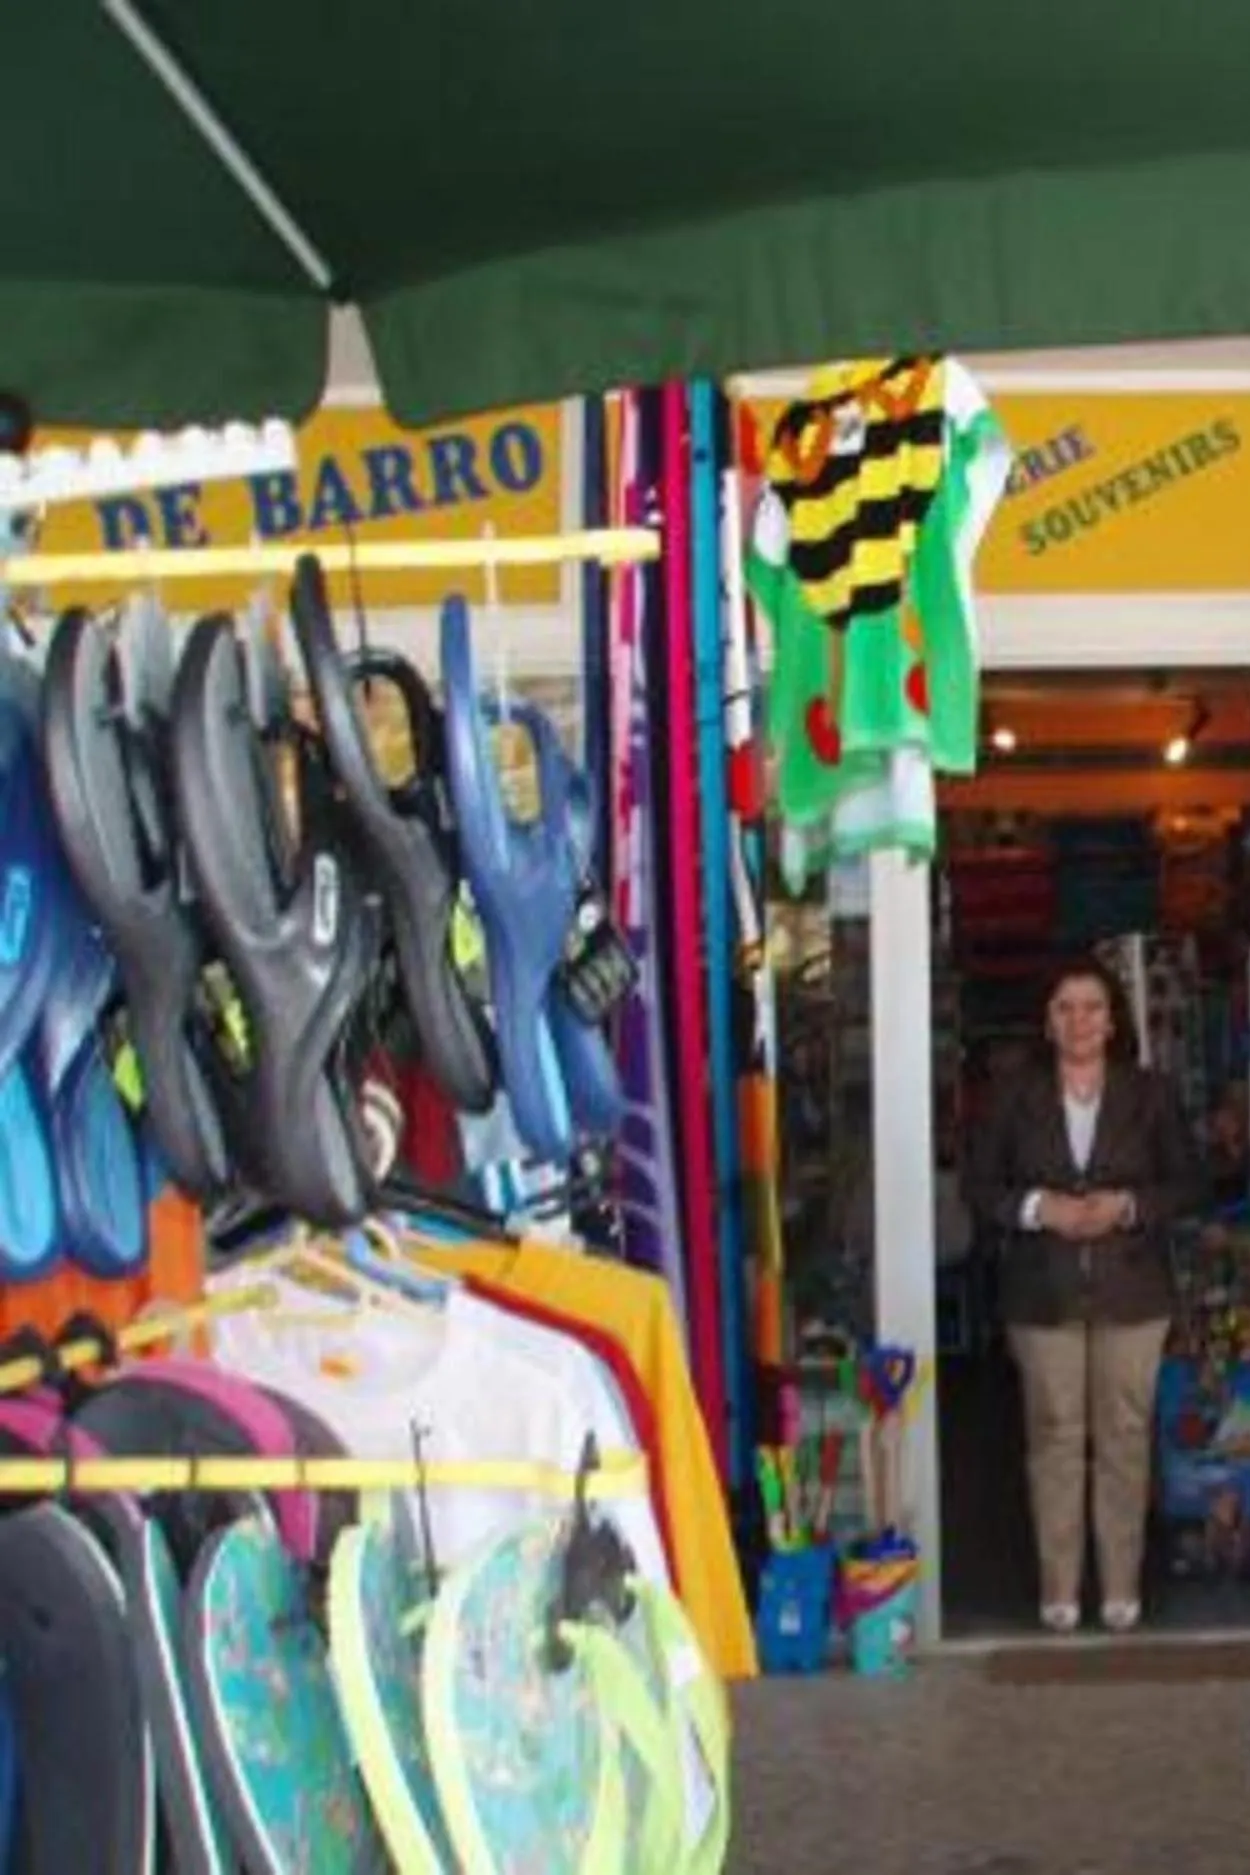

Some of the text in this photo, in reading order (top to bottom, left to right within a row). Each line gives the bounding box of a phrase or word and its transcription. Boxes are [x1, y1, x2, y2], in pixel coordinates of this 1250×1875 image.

[95, 478, 210, 550] DE
[246, 422, 543, 539] BARRO
[1020, 418, 1242, 556] SOUVENIRS
